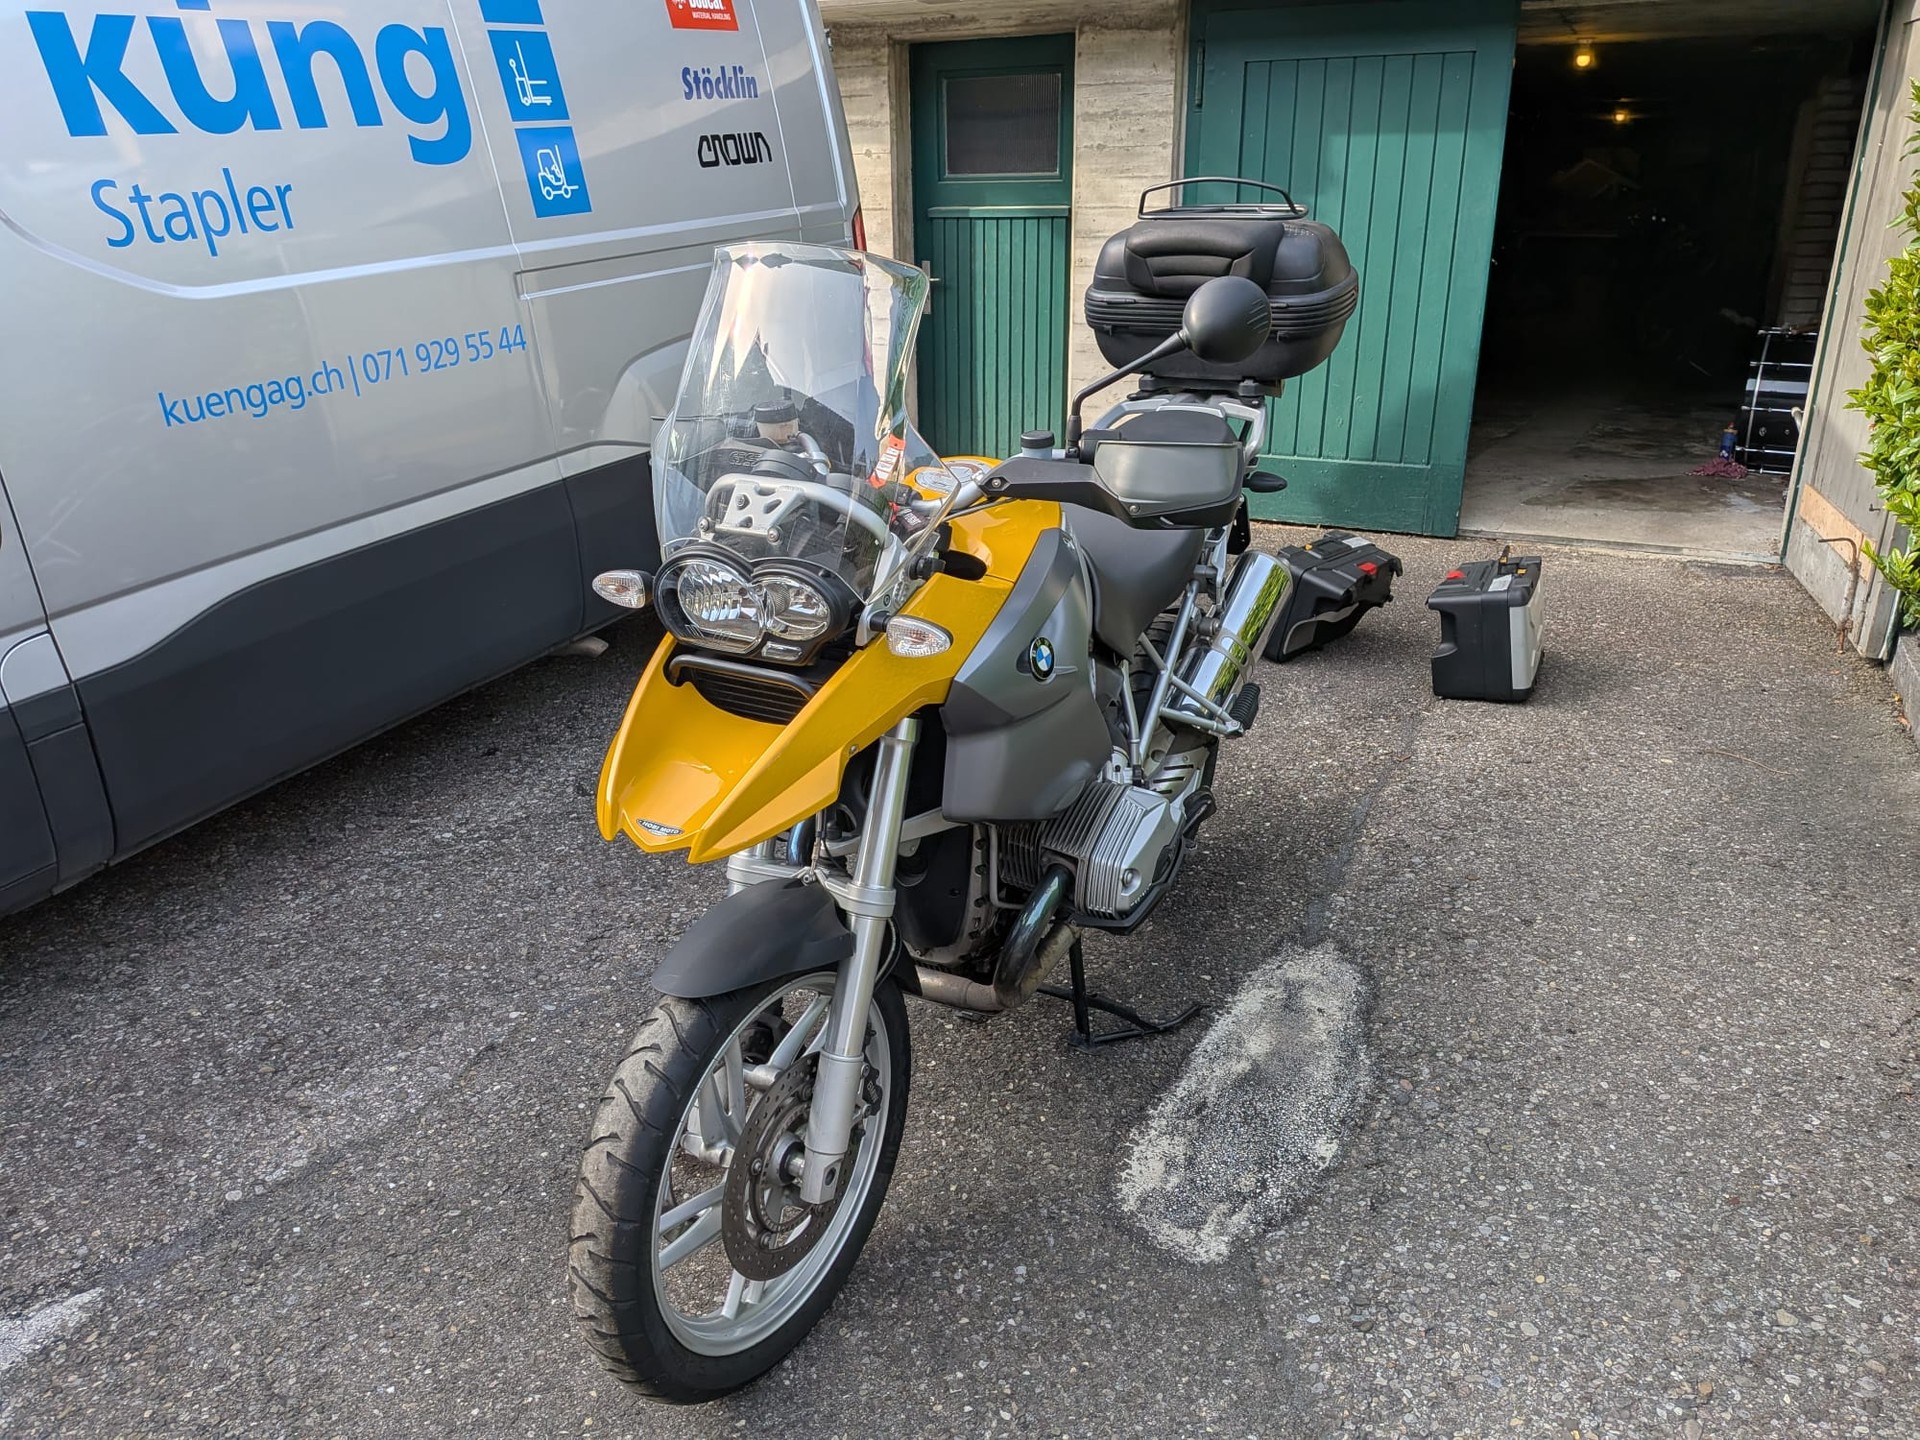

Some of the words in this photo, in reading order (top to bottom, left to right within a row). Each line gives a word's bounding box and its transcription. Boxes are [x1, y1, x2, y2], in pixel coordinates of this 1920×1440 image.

[682, 66, 758, 100] Stöcklin
[698, 132, 772, 168] CROWN
[90, 168, 294, 257] Stapler
[158, 361, 345, 427] kuengag.ch
[362, 347, 409, 384] 071
[415, 337, 460, 373] 929
[464, 330, 494, 362] 55
[499, 324, 527, 353] 44
